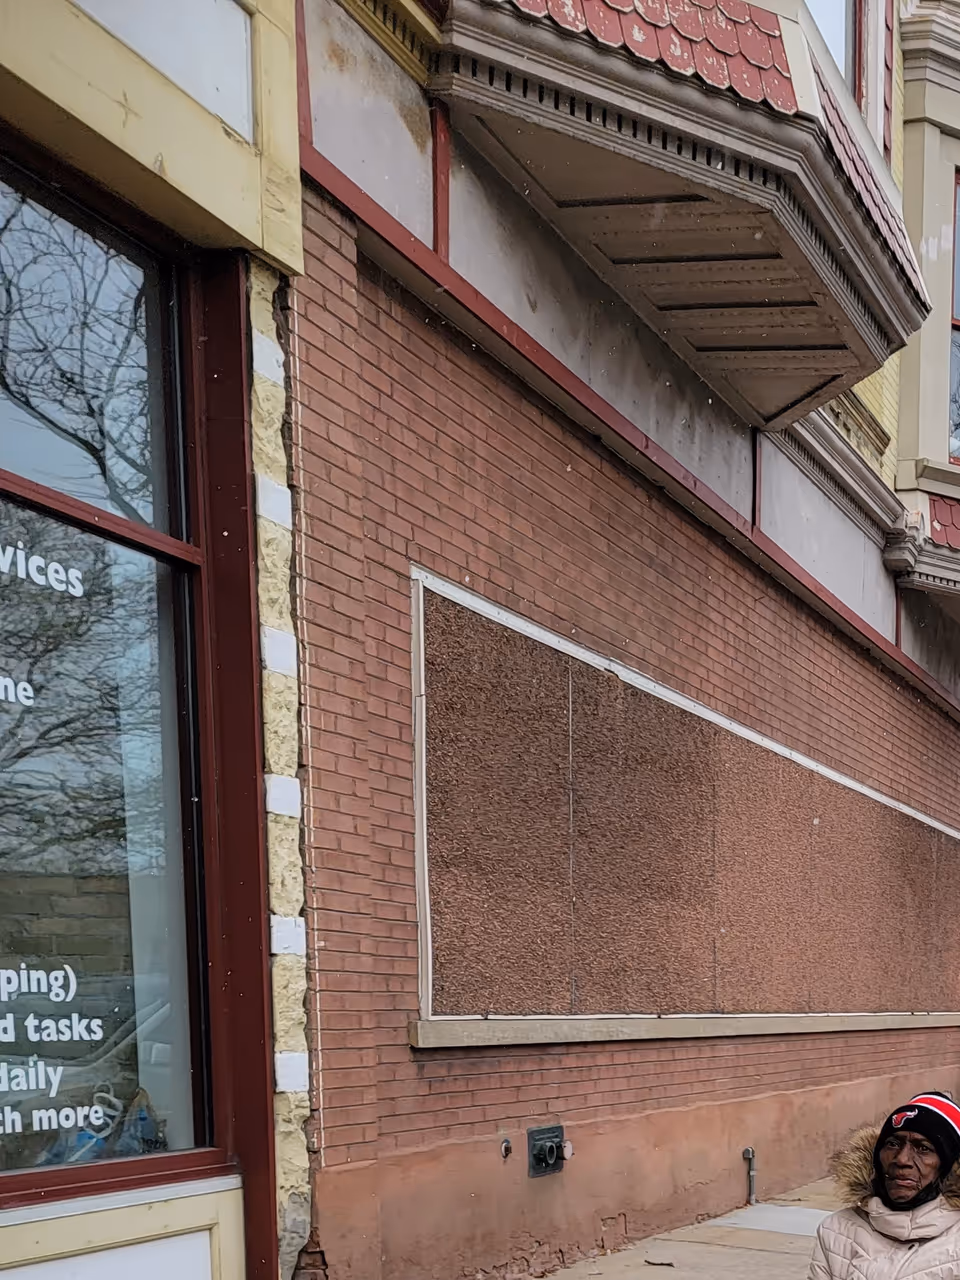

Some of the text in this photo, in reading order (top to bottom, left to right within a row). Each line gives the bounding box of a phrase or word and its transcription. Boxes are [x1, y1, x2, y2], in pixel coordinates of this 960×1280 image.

[0, 541, 84, 598] vices
[0, 962, 77, 1002] ping)
[24, 1013, 104, 1042] tasks
[32, 1103, 105, 1132] more
